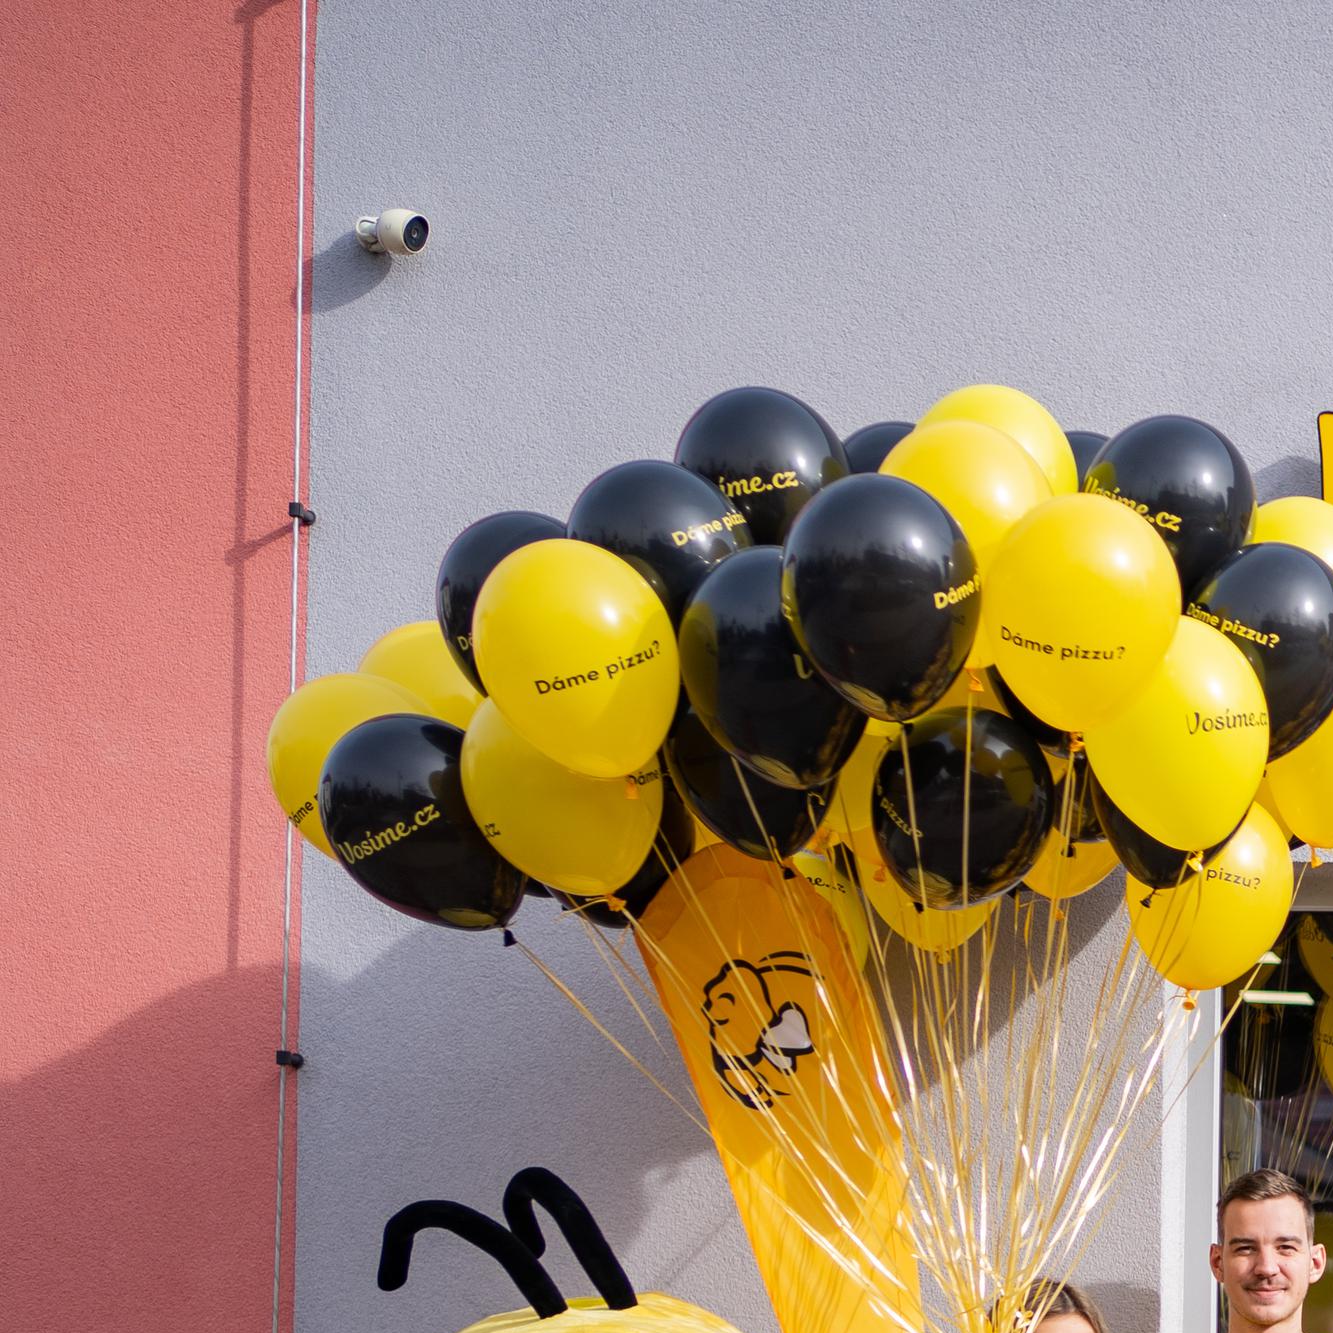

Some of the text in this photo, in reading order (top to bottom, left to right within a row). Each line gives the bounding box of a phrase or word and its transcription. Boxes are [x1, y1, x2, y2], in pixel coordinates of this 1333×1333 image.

[1001, 624, 1126, 661] Dáme pizzu?
[1220, 619, 1281, 648] pizzu?
[535, 639, 661, 695] Dáme pizzu?
[338, 803, 441, 865] Vosíme.cz
[1206, 867, 1262, 890] pizzu?
